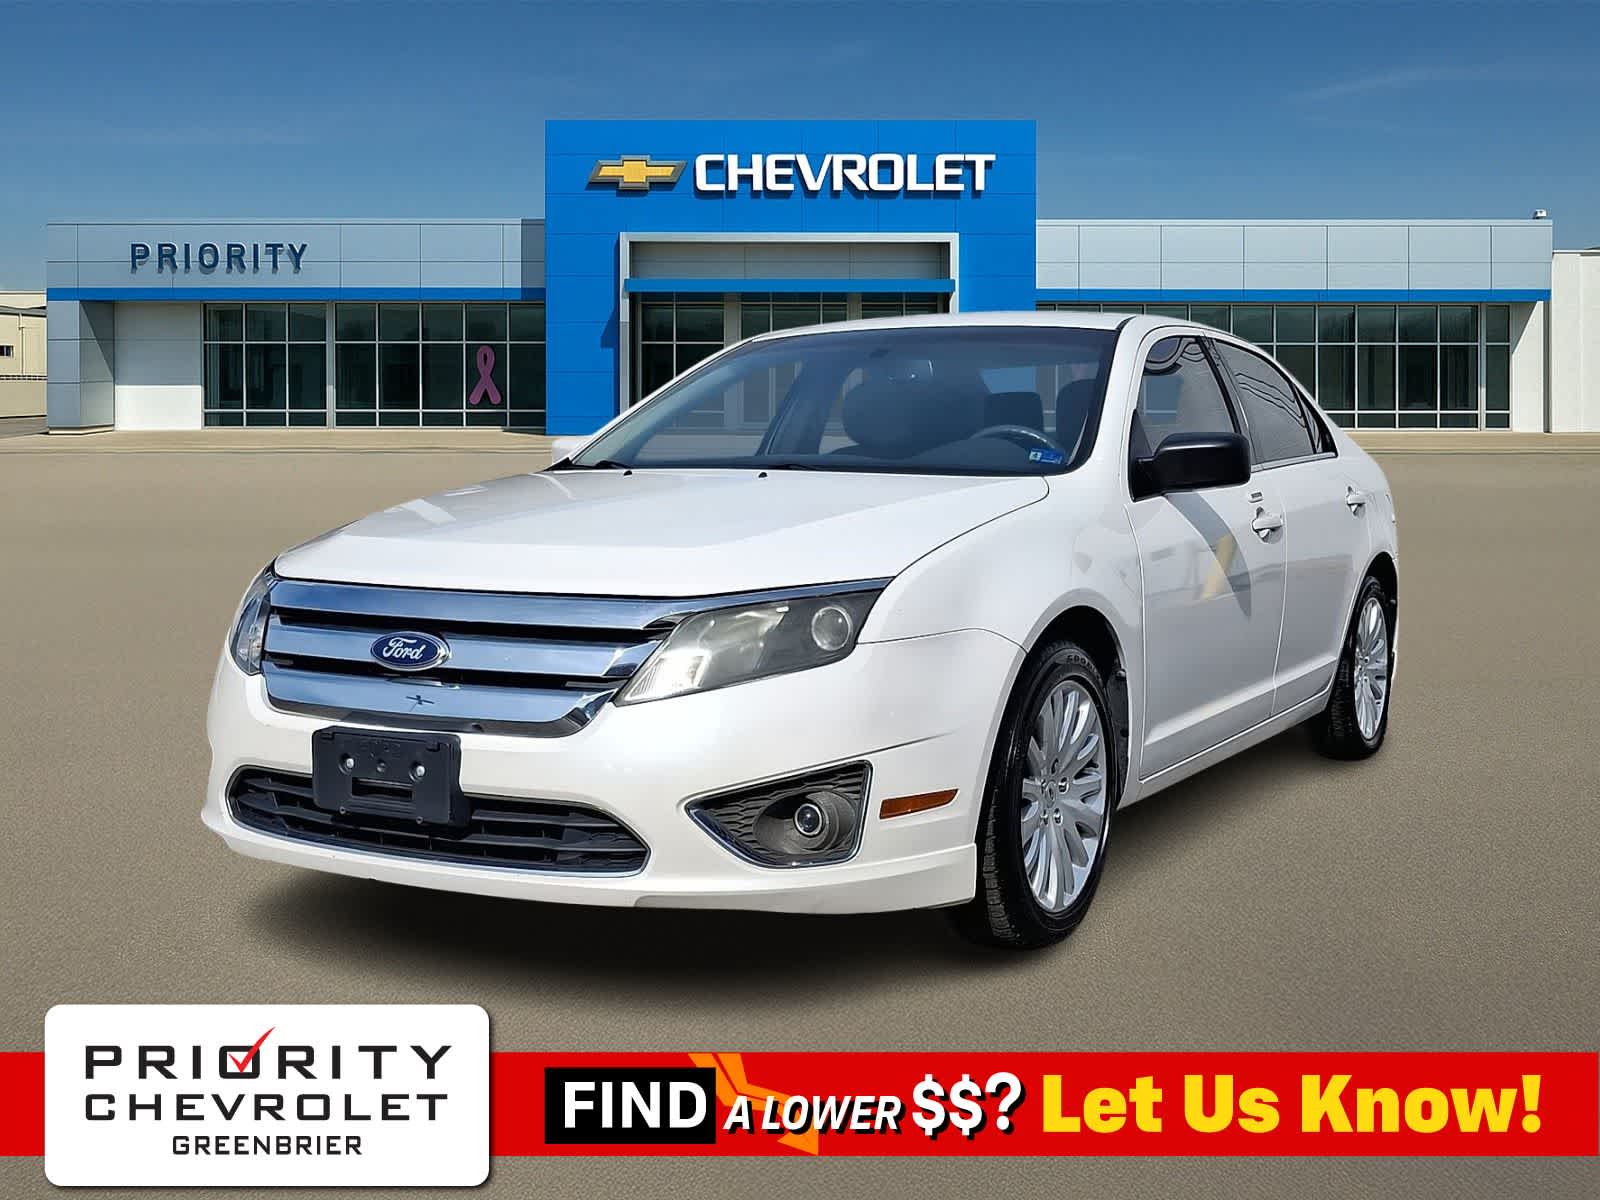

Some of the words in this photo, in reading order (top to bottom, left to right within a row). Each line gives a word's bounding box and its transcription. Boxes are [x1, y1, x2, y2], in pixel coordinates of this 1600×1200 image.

[695, 153, 996, 191] CHEVROLET
[130, 242, 308, 271] PRIORITY
[382, 637, 427, 660] Ford
